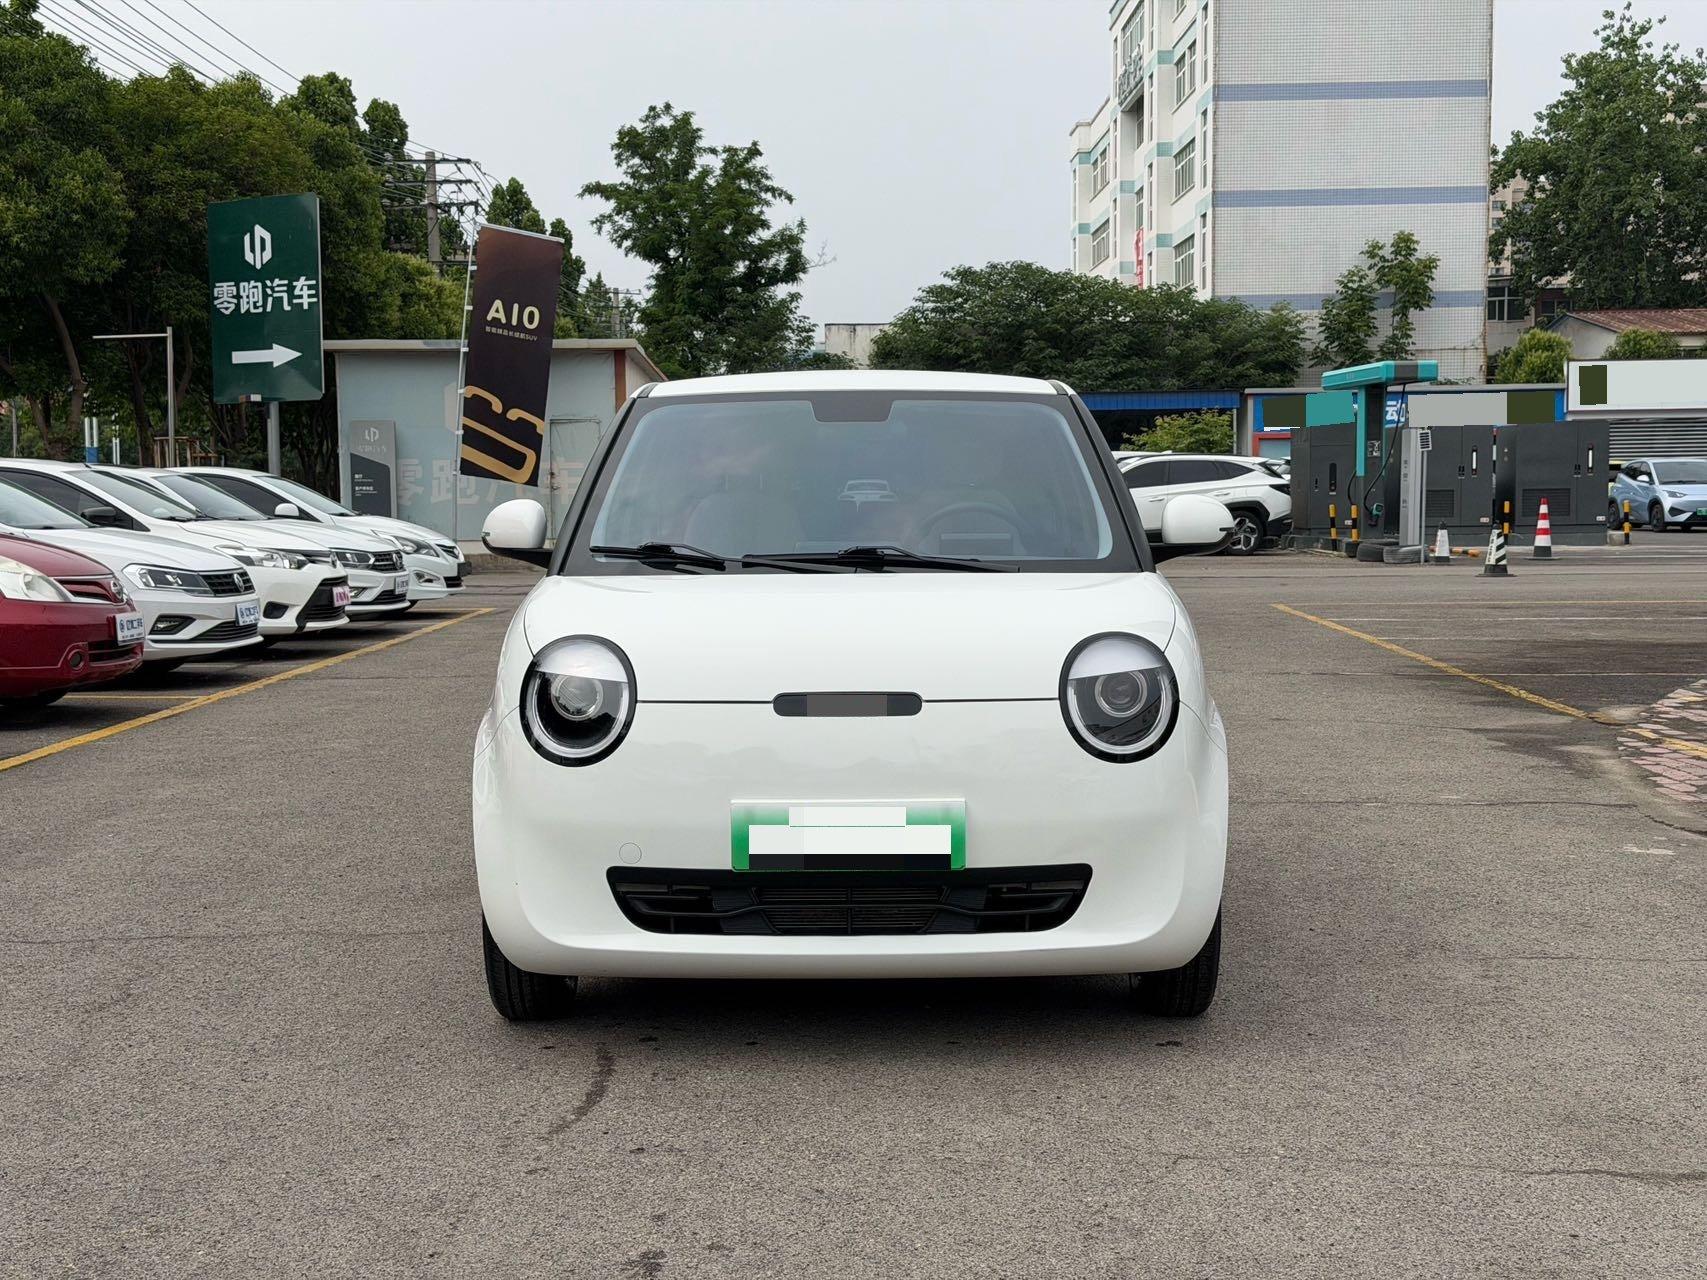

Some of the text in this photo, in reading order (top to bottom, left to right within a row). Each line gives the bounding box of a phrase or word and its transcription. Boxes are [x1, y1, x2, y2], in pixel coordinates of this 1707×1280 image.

[213, 276, 318, 315] 零跑汽车
[486, 299, 540, 330] A10
